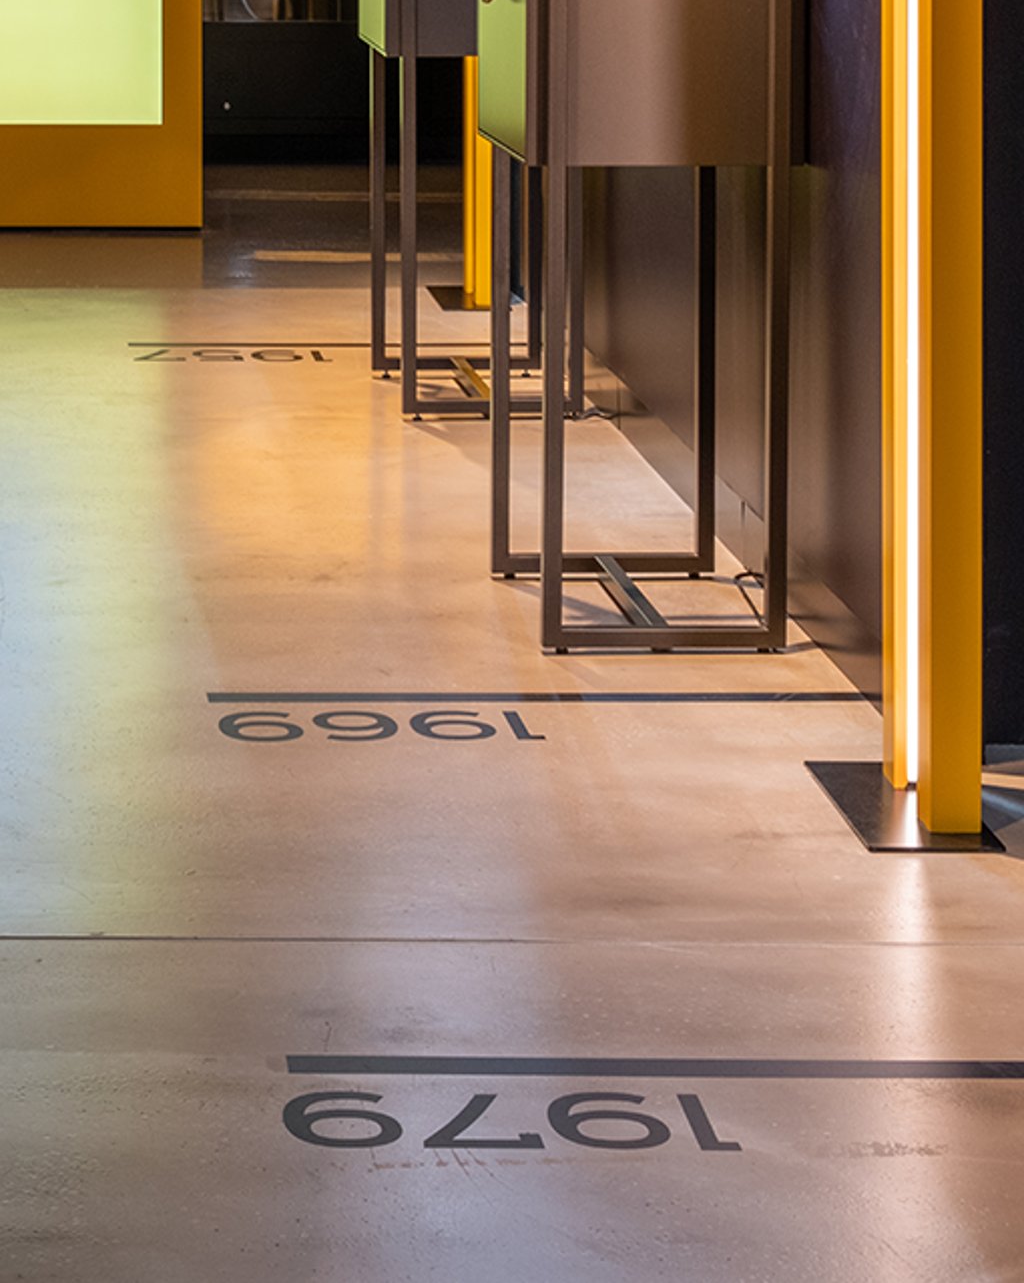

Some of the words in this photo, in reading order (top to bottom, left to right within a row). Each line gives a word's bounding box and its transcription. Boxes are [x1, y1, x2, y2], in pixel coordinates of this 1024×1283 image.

[132, 348, 334, 363] 1957
[218, 710, 547, 742] 1969
[282, 1090, 743, 1151] 1979
